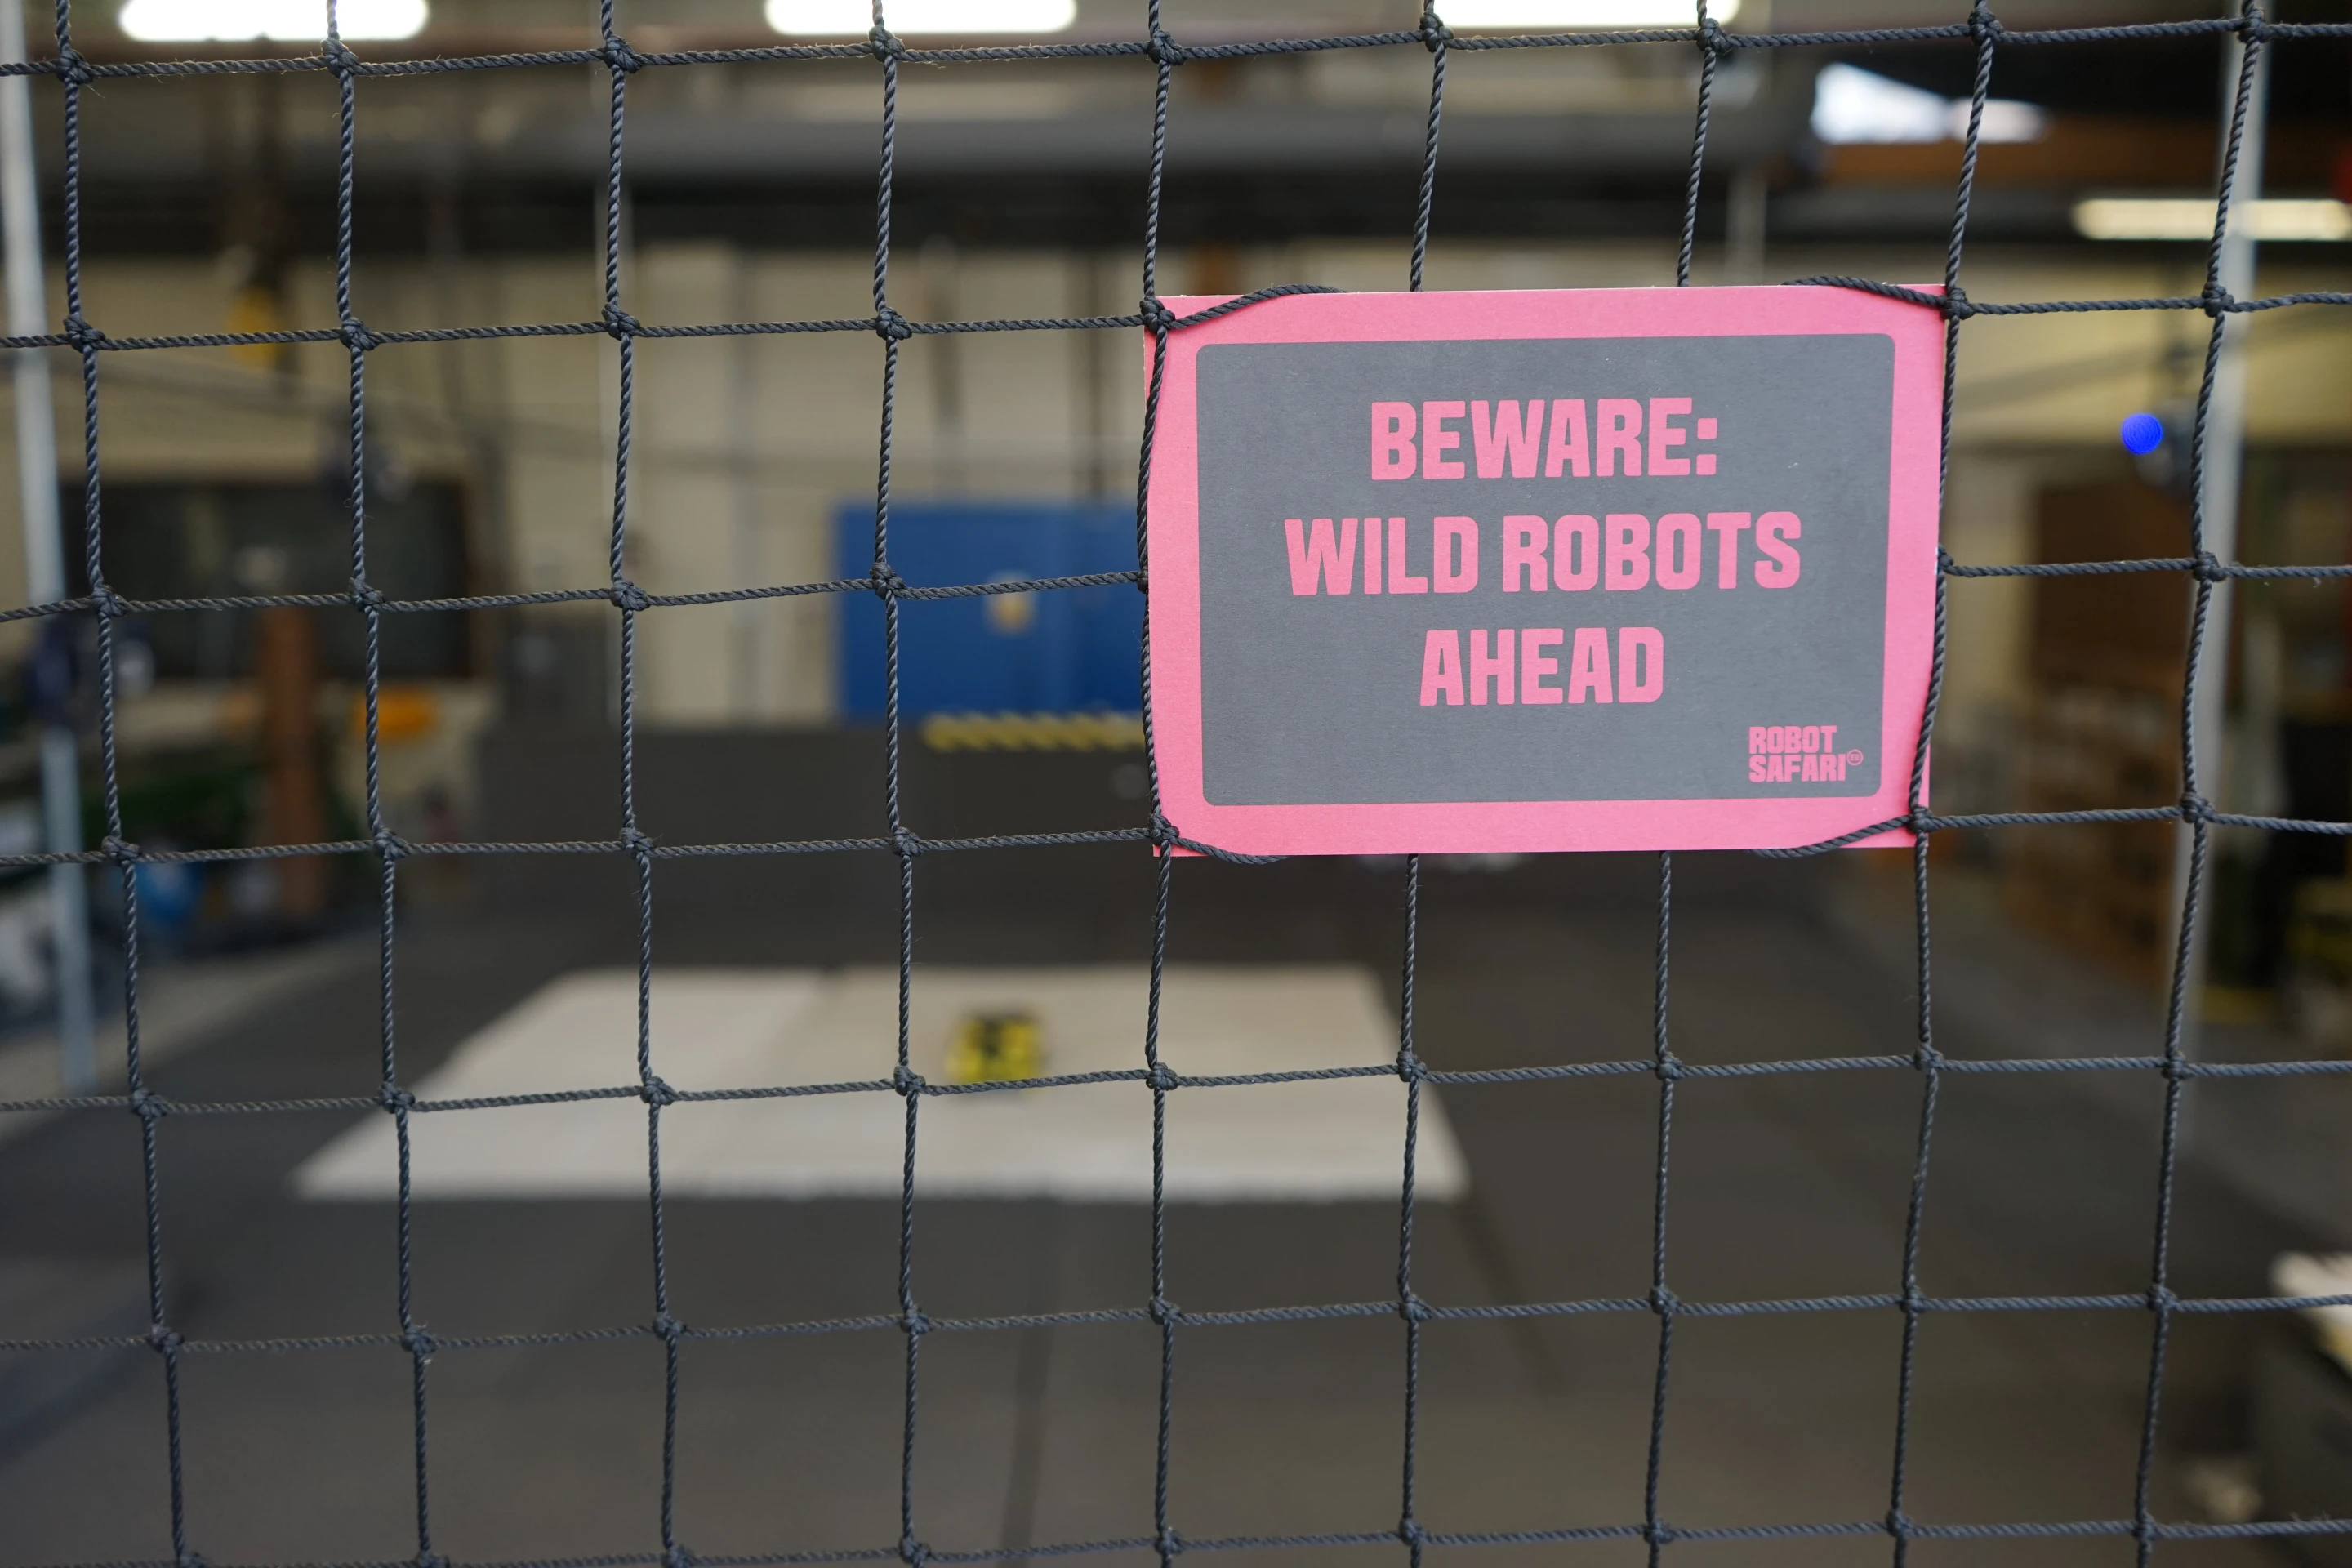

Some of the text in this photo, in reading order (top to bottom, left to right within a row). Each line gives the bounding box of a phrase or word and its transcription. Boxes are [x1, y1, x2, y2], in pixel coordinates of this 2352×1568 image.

[1371, 398, 1717, 480] BEWARE:
[1285, 512, 1801, 595] WILD ROBOTS
[1419, 627, 1664, 706] AHEAD
[1748, 725, 1837, 754] ROBOT
[1748, 754, 1846, 782] SAFARI
